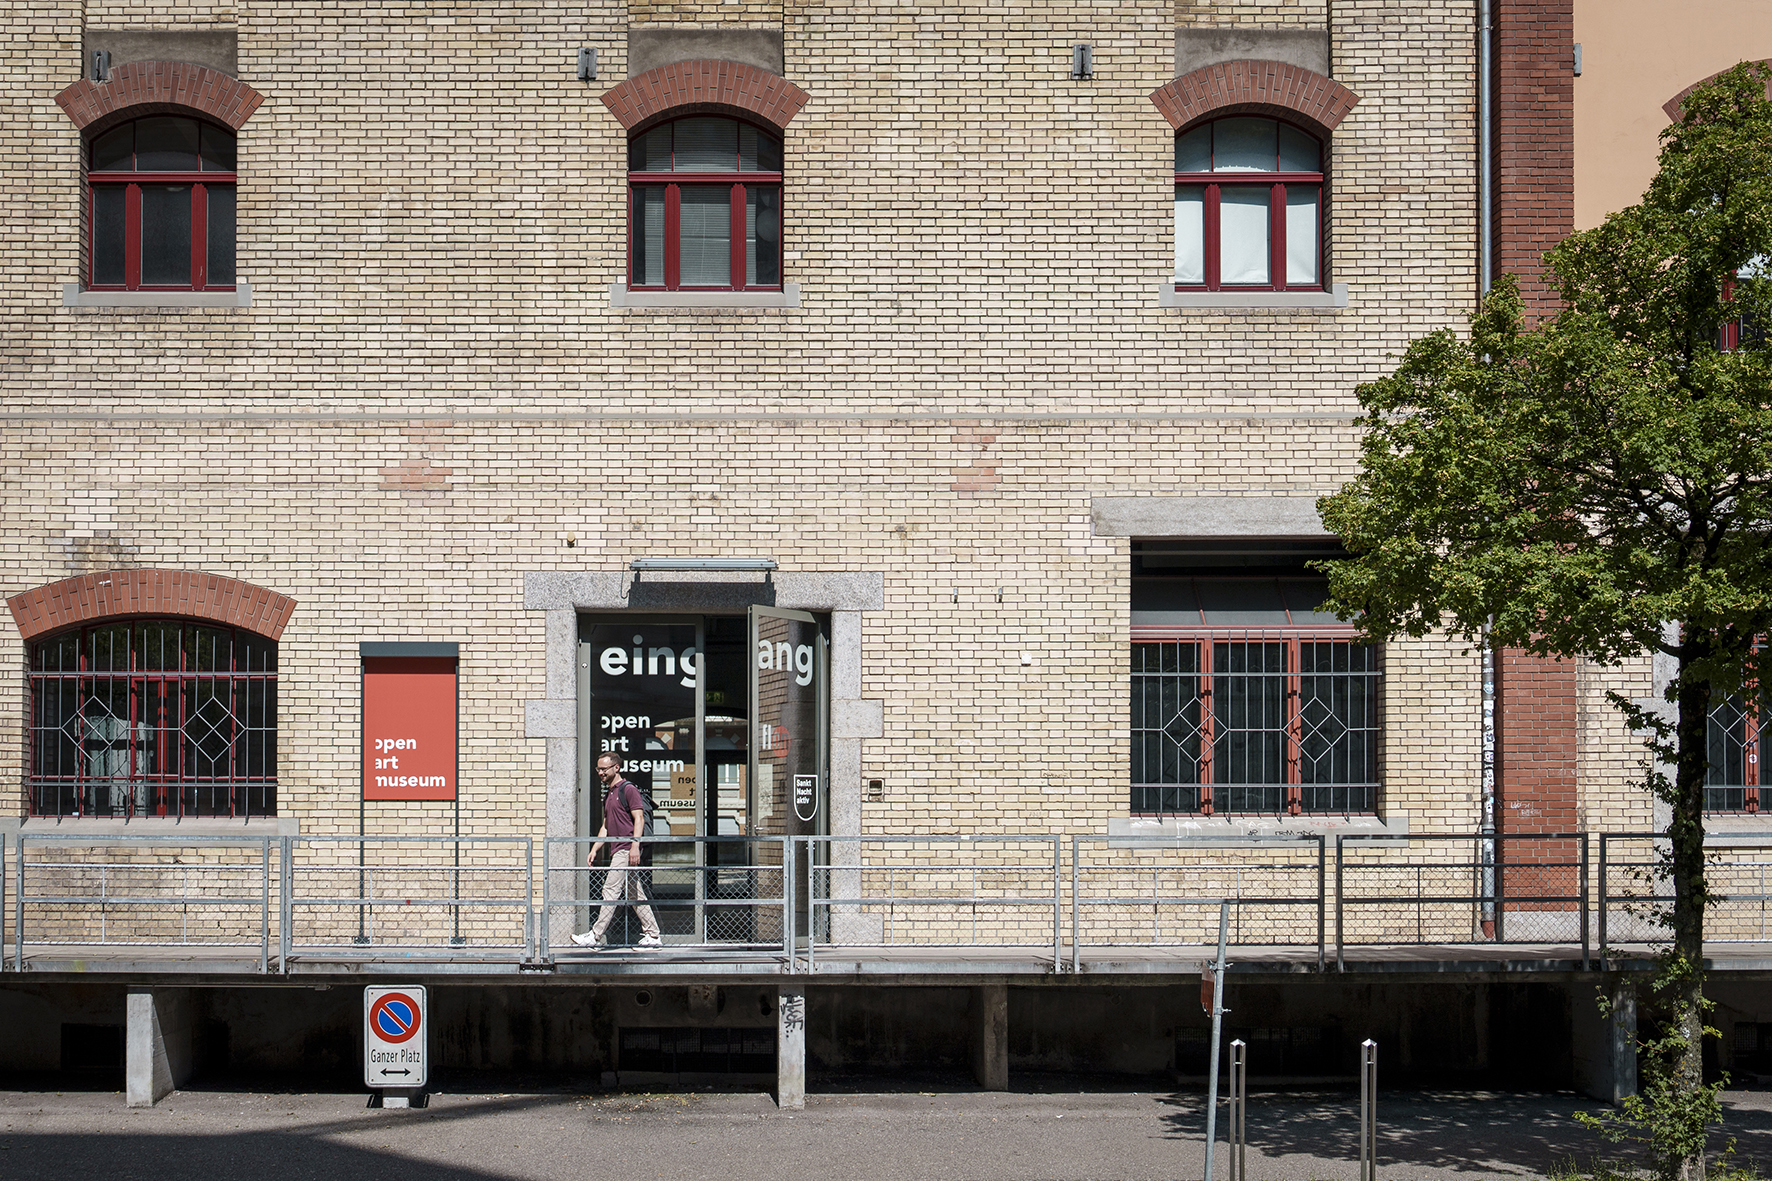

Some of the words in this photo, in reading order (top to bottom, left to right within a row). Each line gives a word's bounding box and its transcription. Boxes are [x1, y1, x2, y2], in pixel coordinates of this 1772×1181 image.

[758, 639, 813, 687] ang
[601, 715, 651, 733] open
[375, 738, 417, 754] open
[601, 736, 629, 752] art
[375, 755, 399, 770] art
[620, 760, 685, 773] useum
[375, 776, 446, 787] museum
[796, 779, 812, 787] Sankt
[796, 787, 813, 796] Nacht
[796, 796, 810, 804] aktiv
[370, 1048, 398, 1063] Ganzer
[400, 1048, 420, 1063] Platz
